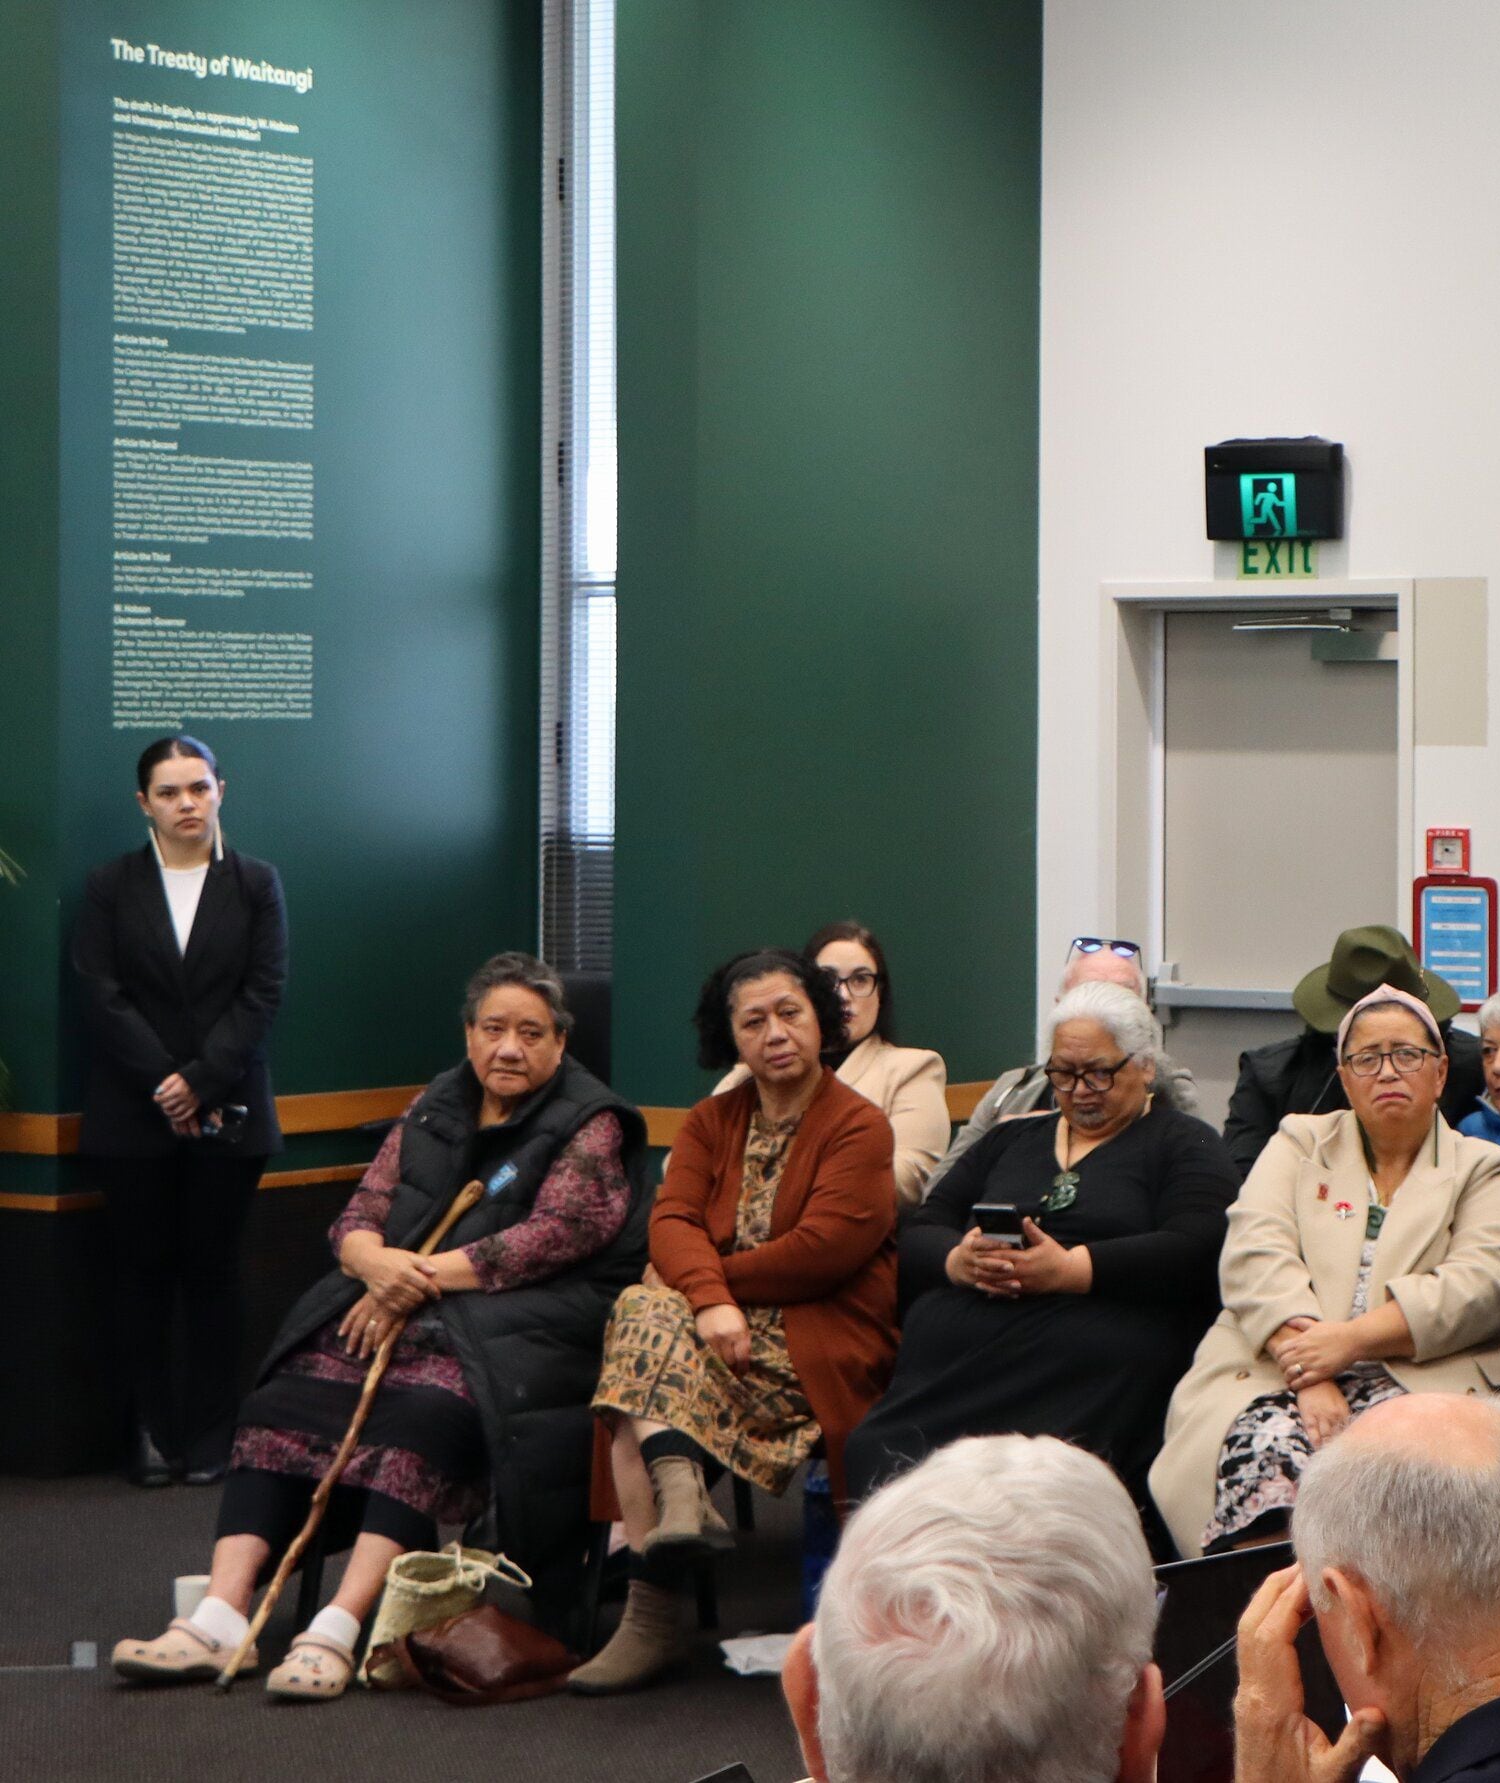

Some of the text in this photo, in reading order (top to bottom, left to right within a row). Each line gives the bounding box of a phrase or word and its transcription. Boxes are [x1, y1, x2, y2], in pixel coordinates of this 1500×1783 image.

[111, 38, 313, 94] The Treaty of Waitangi
